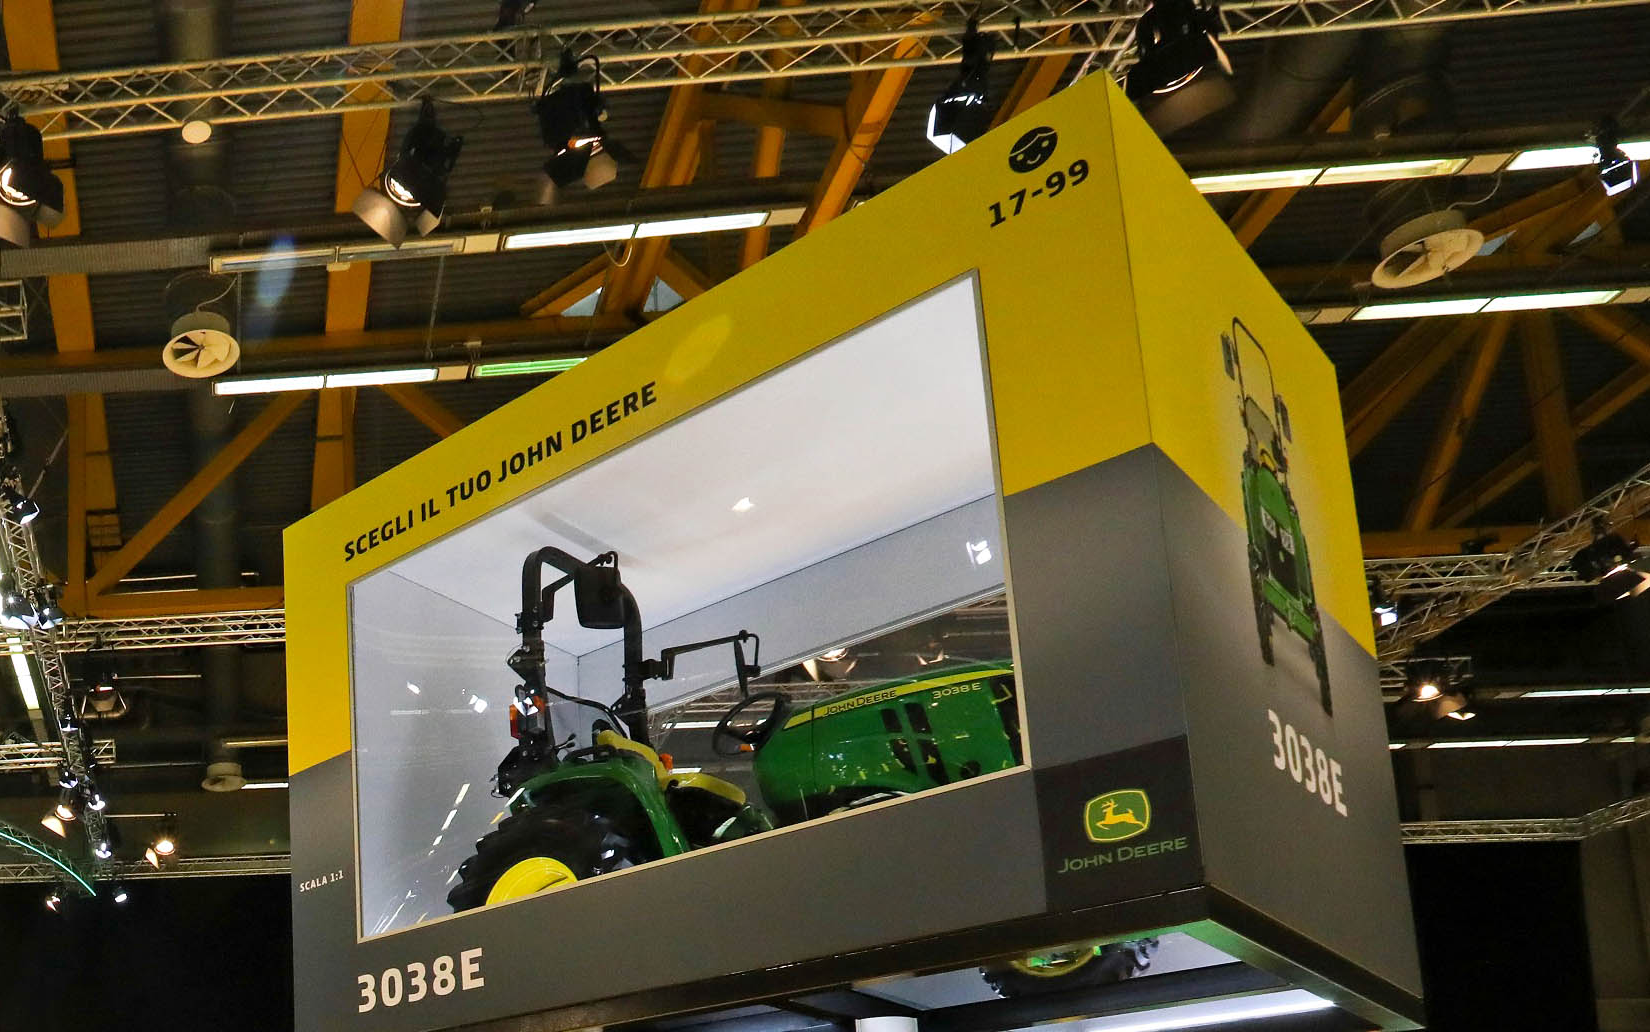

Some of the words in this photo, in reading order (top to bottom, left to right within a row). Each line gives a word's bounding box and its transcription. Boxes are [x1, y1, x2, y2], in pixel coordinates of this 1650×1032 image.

[989, 159, 1089, 228] 17-99
[344, 510, 414, 562] SCEGLI
[421, 498, 440, 523] IL
[446, 470, 492, 508] TUO
[498, 431, 563, 482] JOHN
[571, 381, 657, 445] DEERE
[823, 700, 855, 717] JOHN
[855, 690, 897, 707] DEERE
[1267, 708, 1348, 817] 3038E
[299, 875, 328, 893] SCALA
[330, 869, 344, 883] 1:1
[1058, 852, 1113, 873] JOHN
[1117, 836, 1190, 862] DEERE
[357, 947, 485, 1013] 3038E
